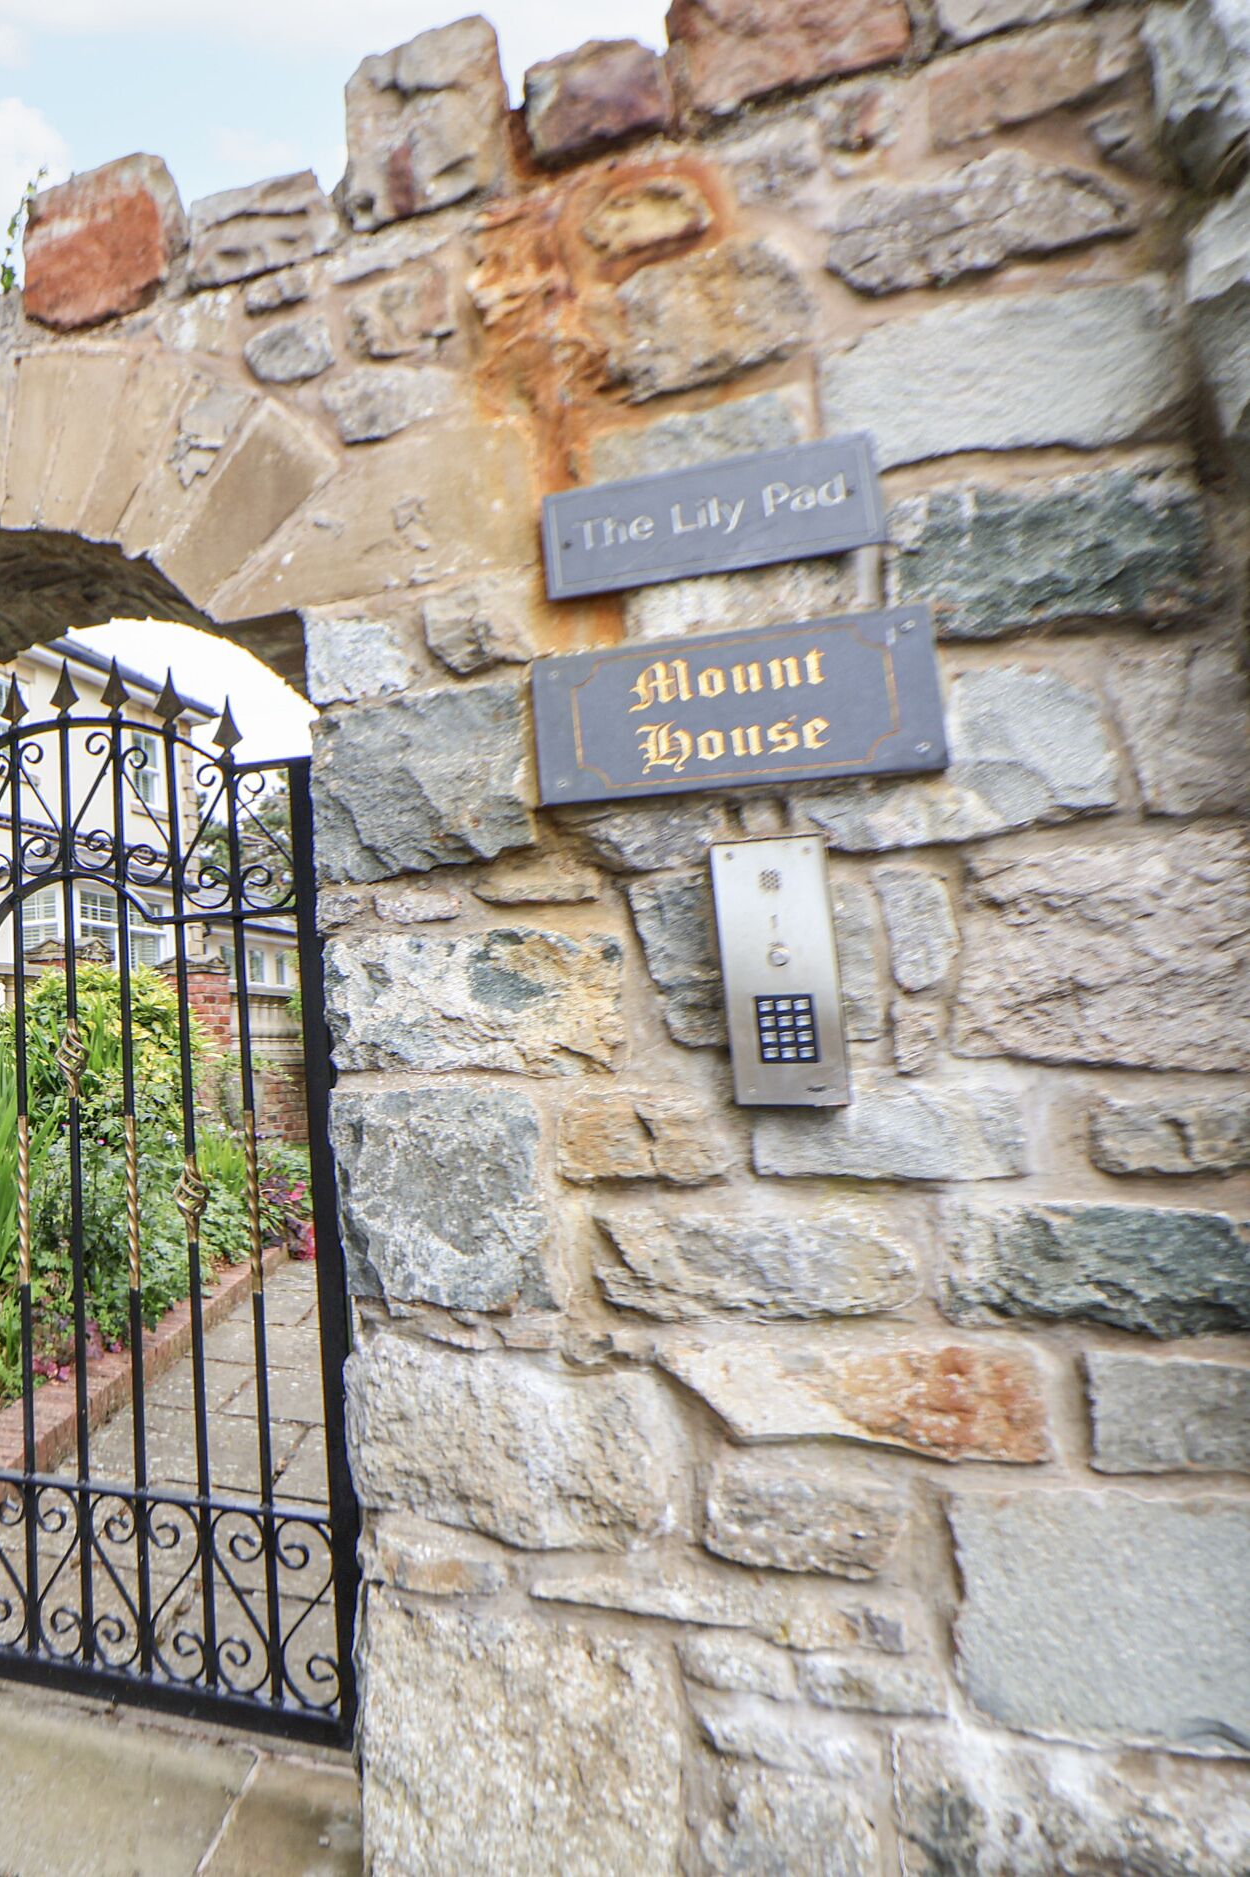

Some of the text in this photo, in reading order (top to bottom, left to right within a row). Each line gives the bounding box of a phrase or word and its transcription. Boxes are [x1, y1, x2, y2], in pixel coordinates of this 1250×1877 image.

[572, 472, 847, 550] The Lily Pad
[628, 647, 826, 713] Mount
[635, 715, 831, 775] House
